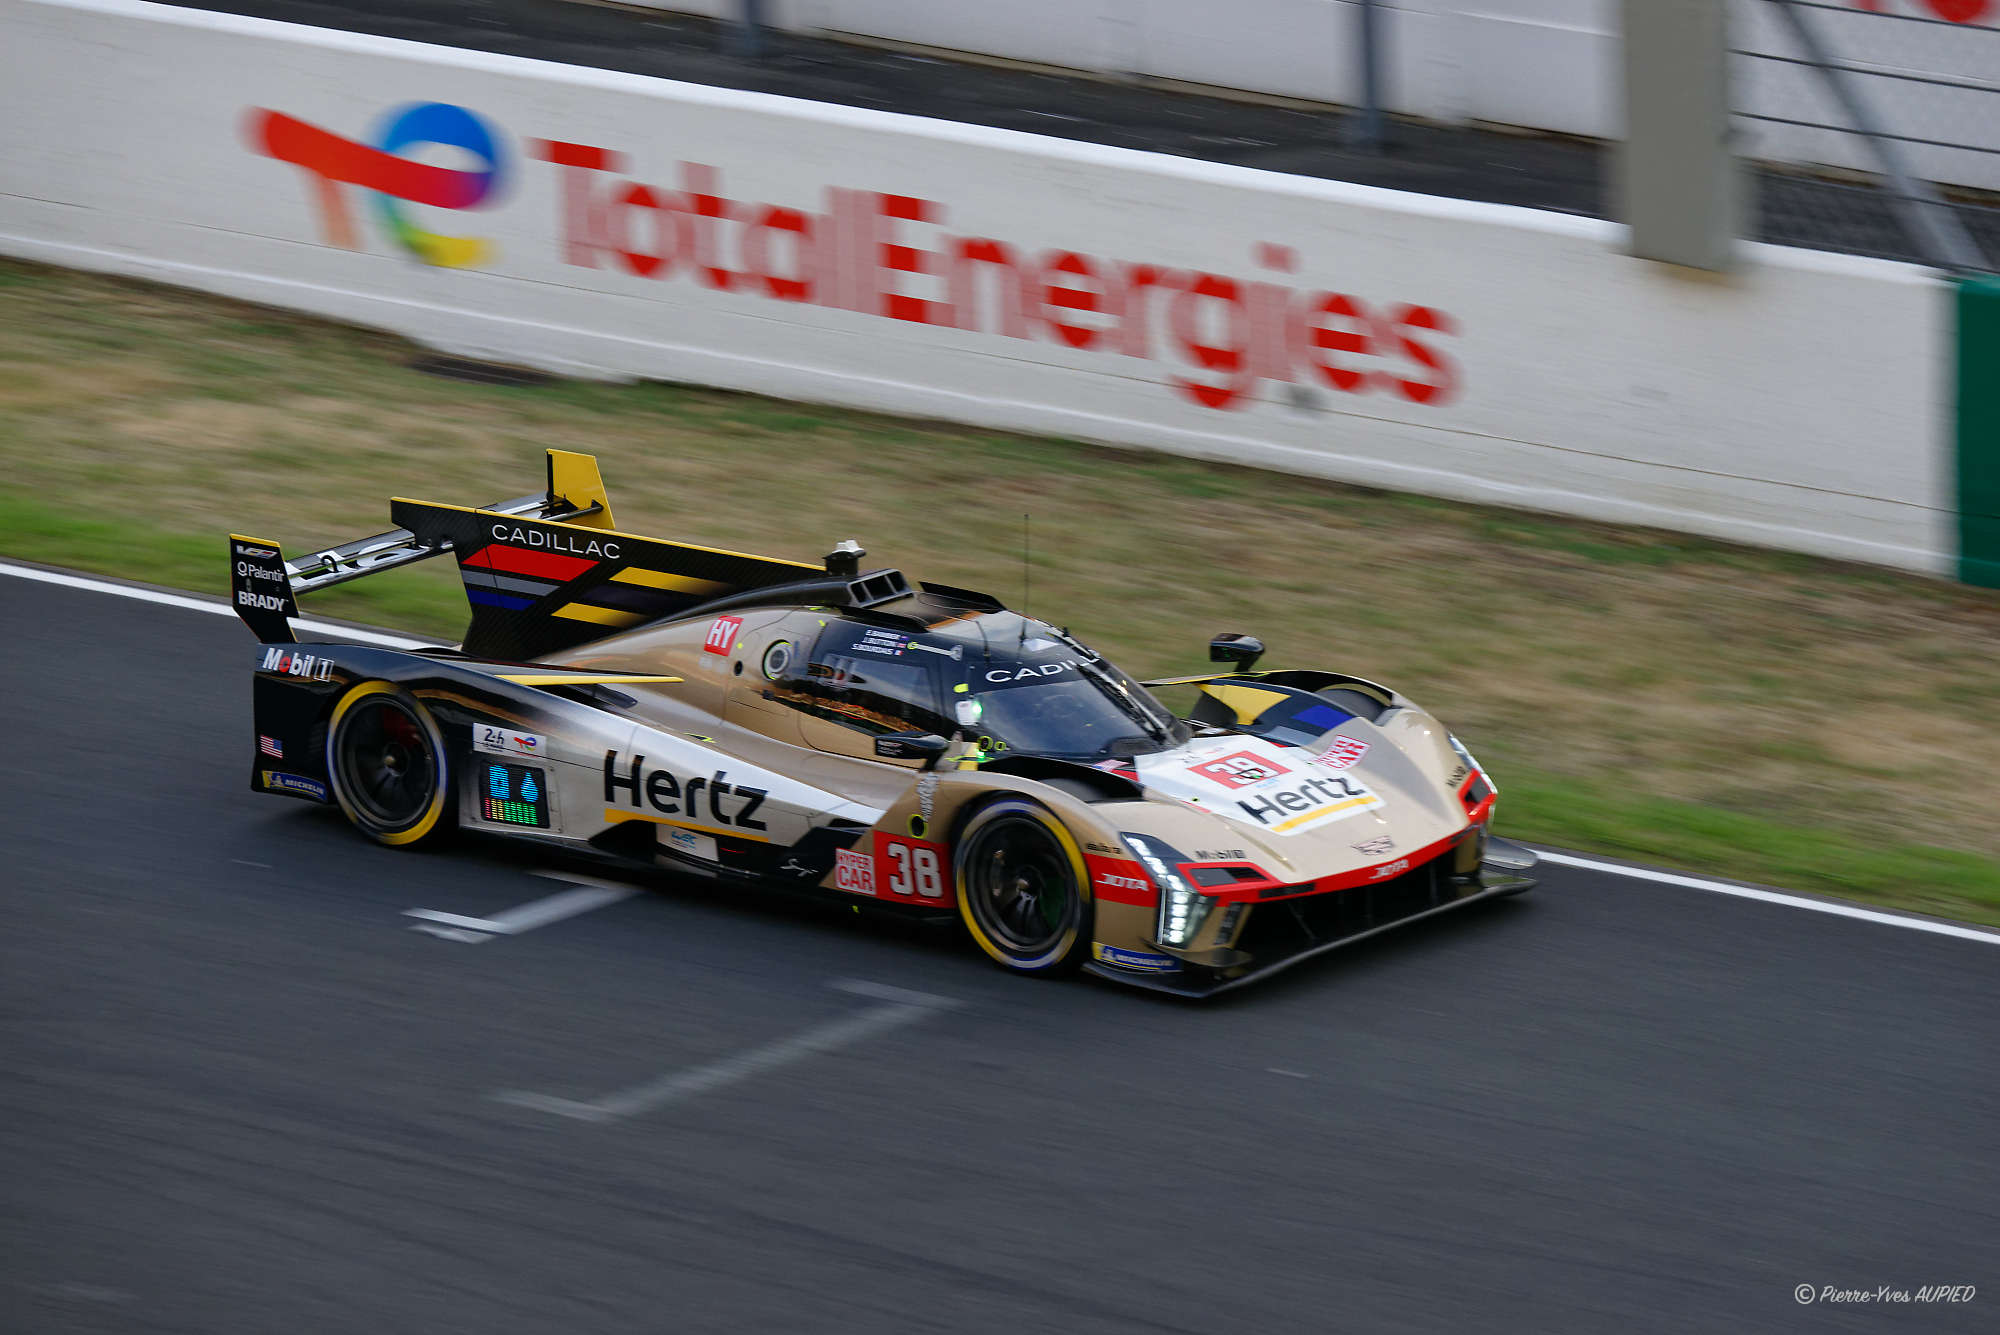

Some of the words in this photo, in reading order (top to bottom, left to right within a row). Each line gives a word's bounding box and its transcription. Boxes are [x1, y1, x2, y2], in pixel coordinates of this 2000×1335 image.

[524, 137, 1463, 411] TotalEnergies
[491, 524, 620, 559] CADILLAC
[247, 563, 285, 582] Palantir
[238, 591, 285, 612] BRADY
[707, 619, 739, 648] HY
[262, 647, 315, 678] Mobil
[604, 749, 769, 832] Hertz
[1237, 777, 1367, 825] Hertz
[837, 849, 874, 869] HYPER
[886, 841, 944, 898] 38
[838, 864, 875, 892] CAR
